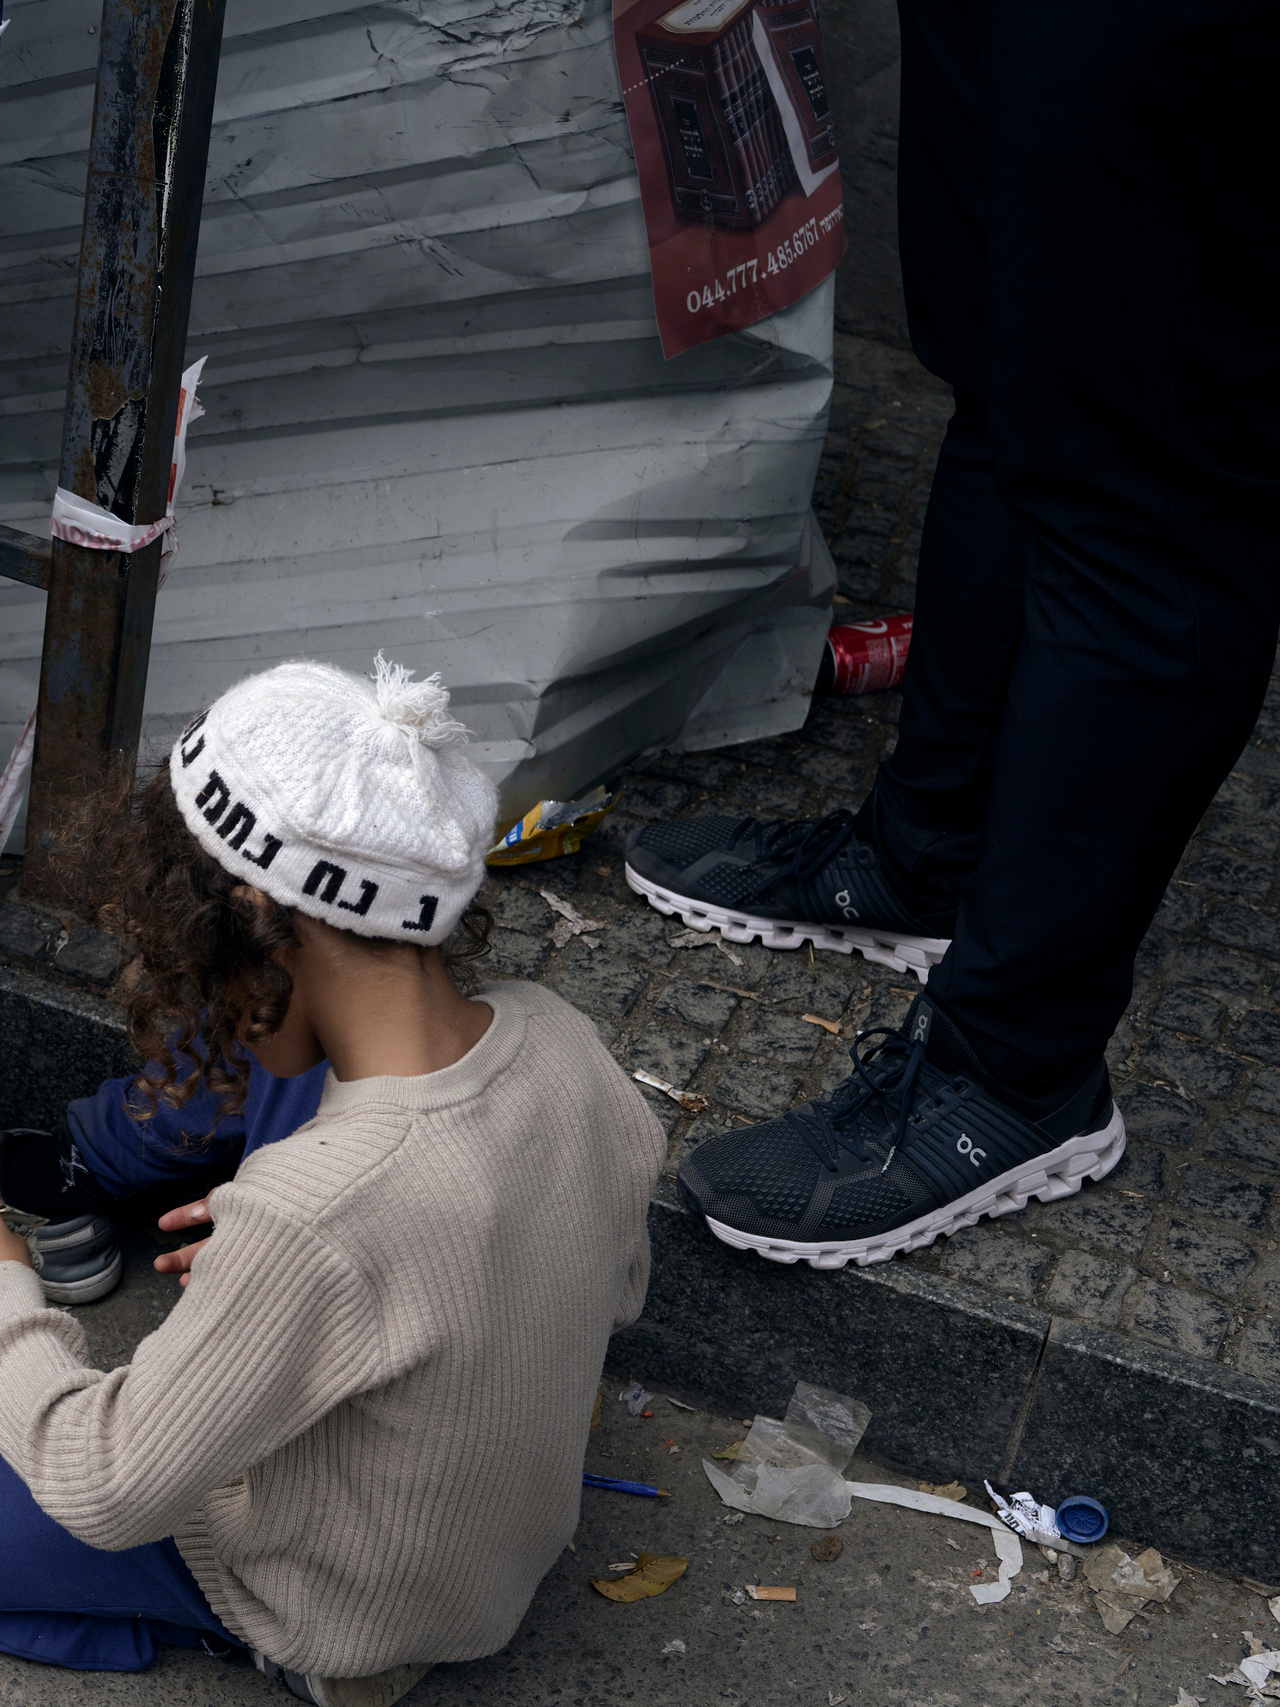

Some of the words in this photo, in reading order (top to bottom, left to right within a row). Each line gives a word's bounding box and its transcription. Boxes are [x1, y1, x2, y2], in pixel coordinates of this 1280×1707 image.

[686, 217, 819, 313] 044.777.485.6767
[194, 769, 284, 870] נחמ
[302, 860, 379, 916] נח
[401, 894, 439, 932] נ
